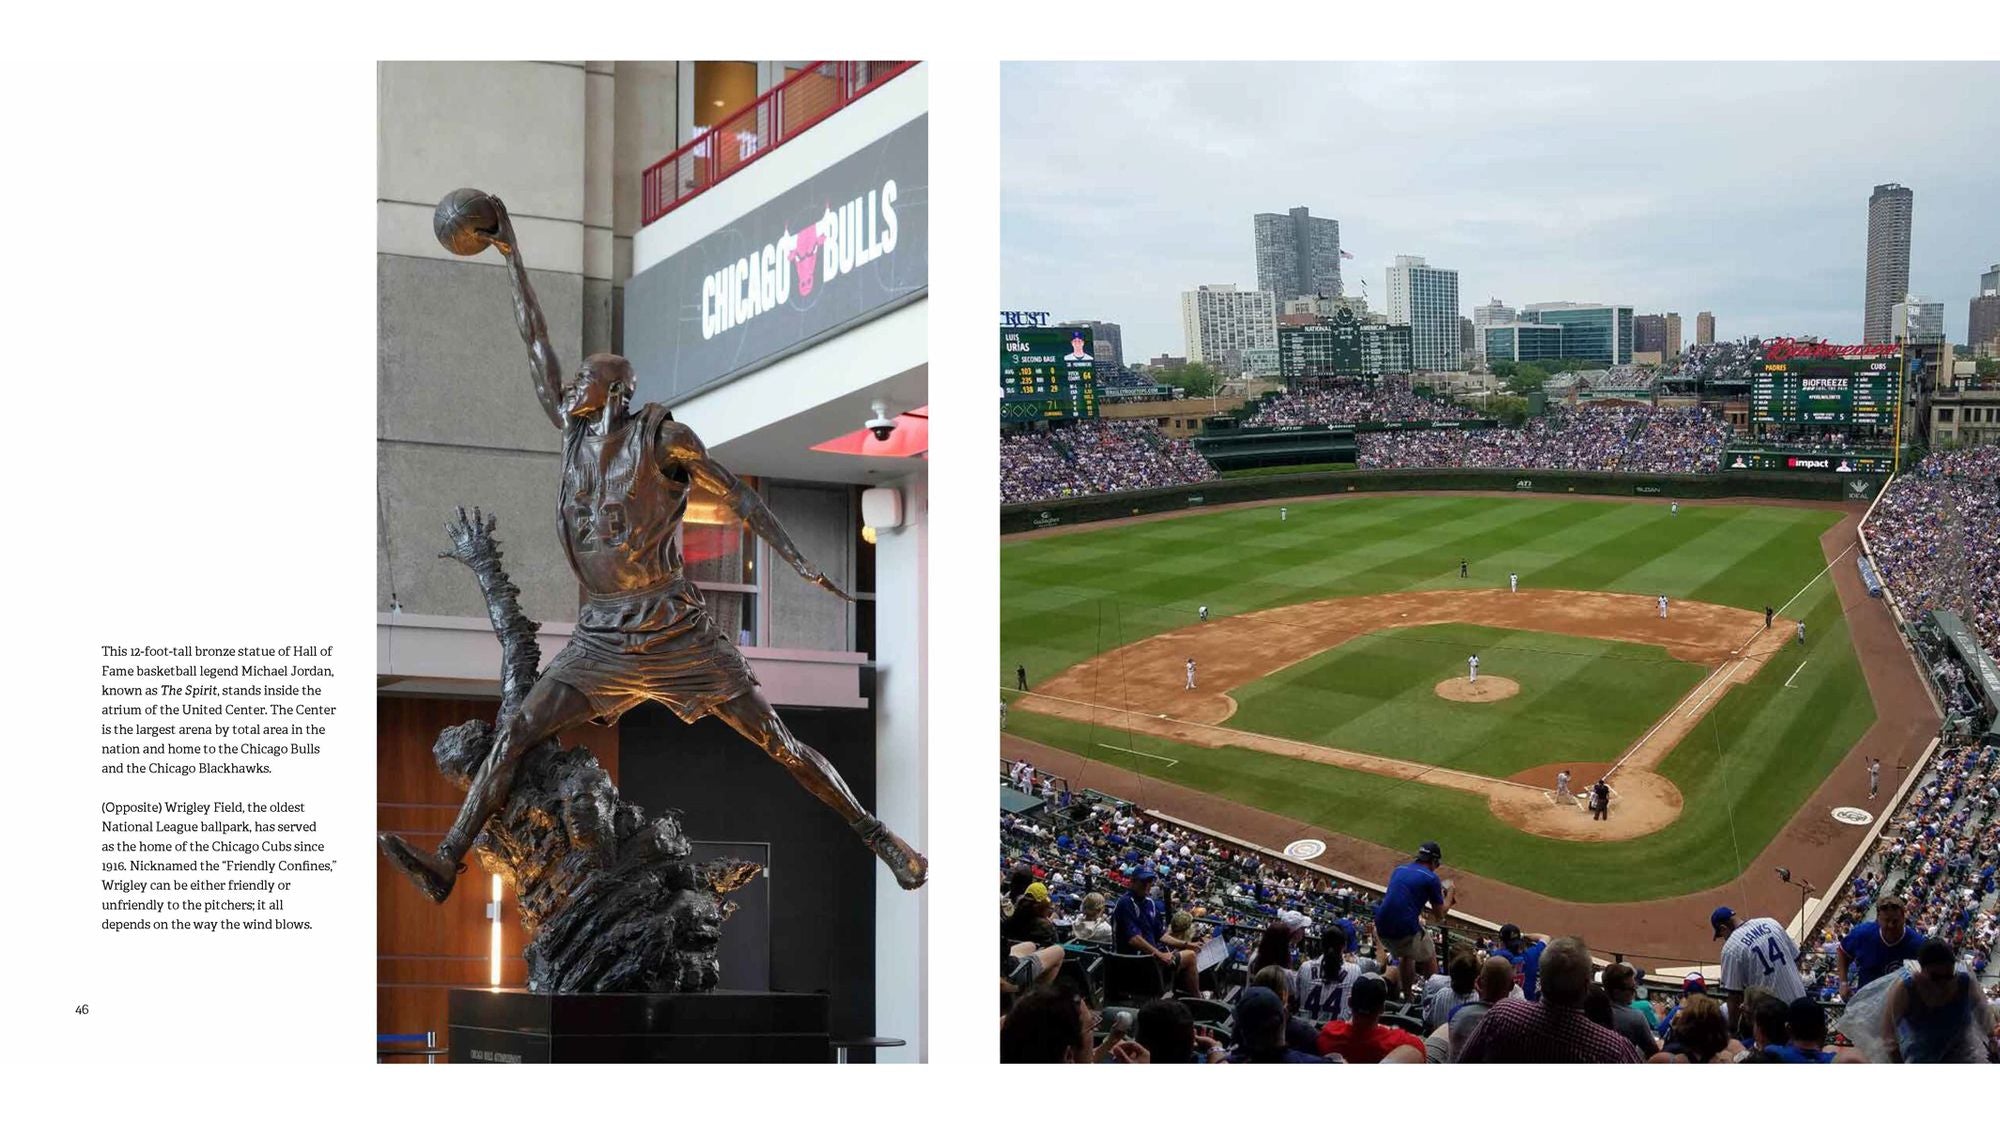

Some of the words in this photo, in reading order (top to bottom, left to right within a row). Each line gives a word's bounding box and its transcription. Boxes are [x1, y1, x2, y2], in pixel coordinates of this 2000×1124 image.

[702, 235, 791, 340] CHICAGO
[823, 179, 898, 284] BULLS
[1005, 333, 1019, 341] LUIS
[1765, 364, 1787, 372] PADRES
[1870, 363, 1887, 371] CUBS
[1802, 378, 1849, 387] BIOFREEZE
[1796, 458, 1829, 469] impact
[102, 646, 127, 657] This
[131, 646, 192, 657] 12-foot-tall
[195, 646, 235, 657] bronze
[238, 648, 275, 657] statue
[278, 646, 291, 657] of
[294, 646, 317, 657] Hall
[320, 646, 333, 657] of
[102, 666, 134, 677] Fame
[137, 666, 196, 677] basketball
[200, 666, 238, 680] legend
[242, 666, 287, 677] Michael
[291, 666, 334, 678] Jordan,
[102, 685, 142, 696] known
[145, 688, 157, 696] as
[161, 685, 182, 696] The
[185, 685, 219, 699] Spirit,
[222, 685, 261, 696] stands
[264, 685, 299, 696] inside
[302, 685, 321, 696] the
[102, 705, 141, 716] atrium
[145, 705, 158, 716] of
[160, 705, 179, 716] the
[182, 705, 222, 716] United
[225, 704, 267, 716] Center.
[270, 704, 293, 716] The
[296, 705, 336, 716] Center
[102, 724, 111, 735] is
[114, 724, 133, 735] the
[136, 724, 175, 738] largest
[179, 727, 212, 735] arena
[215, 724, 229, 738] by
[233, 724, 260, 735] total
[263, 727, 288, 735] area
[292, 724, 303, 735] in
[306, 724, 325, 735] the
[102, 744, 140, 755] nation
[143, 744, 164, 755] and
[168, 744, 200, 755] home
[204, 745, 216, 755] to
[219, 744, 238, 755] the
[241, 743, 288, 758] Chicago
[291, 744, 320, 755] Bulls
[102, 763, 123, 774] and
[127, 763, 146, 774] the
[149, 763, 196, 777] Chicago
[199, 763, 271, 774] Blackhawks.
[102, 802, 162, 816] (Opposite)
[165, 802, 210, 816] Wrigley
[214, 802, 245, 814] Field,
[248, 802, 267, 813] the
[270, 802, 304, 813] oldest
[103, 821, 153, 833] National
[157, 821, 198, 835] League
[201, 821, 251, 835] ballpark,
[255, 821, 275, 833] has
[278, 821, 316, 833] served
[102, 844, 114, 852] as
[117, 841, 136, 852] the
[139, 841, 172, 852] home
[175, 841, 188, 852] of
[190, 841, 209, 852] the
[212, 841, 259, 855] Chicago
[262, 841, 291, 852] Cubs
[294, 841, 324, 853] since
[102, 862, 126, 873] 1916.
[130, 861, 197, 872] Nicknamed
[200, 861, 219, 872] the
[102, 880, 147, 894] Wrigley
[150, 882, 170, 891] can
[174, 880, 187, 891] be
[190, 880, 226, 891] either
[229, 880, 275, 894] friendly
[278, 883, 291, 891] or
[102, 900, 164, 913] unfriendly
[168, 901, 179, 911] to
[183, 900, 201, 911] the
[205, 900, 255, 913] pitchers;
[258, 900, 265, 911] it
[269, 900, 283, 911] all
[102, 919, 150, 933] depends
[153, 922, 168, 930] on
[171, 919, 191, 930] the
[193, 922, 218, 933] way
[221, 919, 240, 930] the
[243, 919, 272, 930] wind
[275, 919, 312, 930] blows.
[1741, 923, 1772, 947] BANKS
[1751, 936, 1787, 976] 14
[75, 1004, 90, 1015] 46
[1304, 984, 1343, 1021] 44
